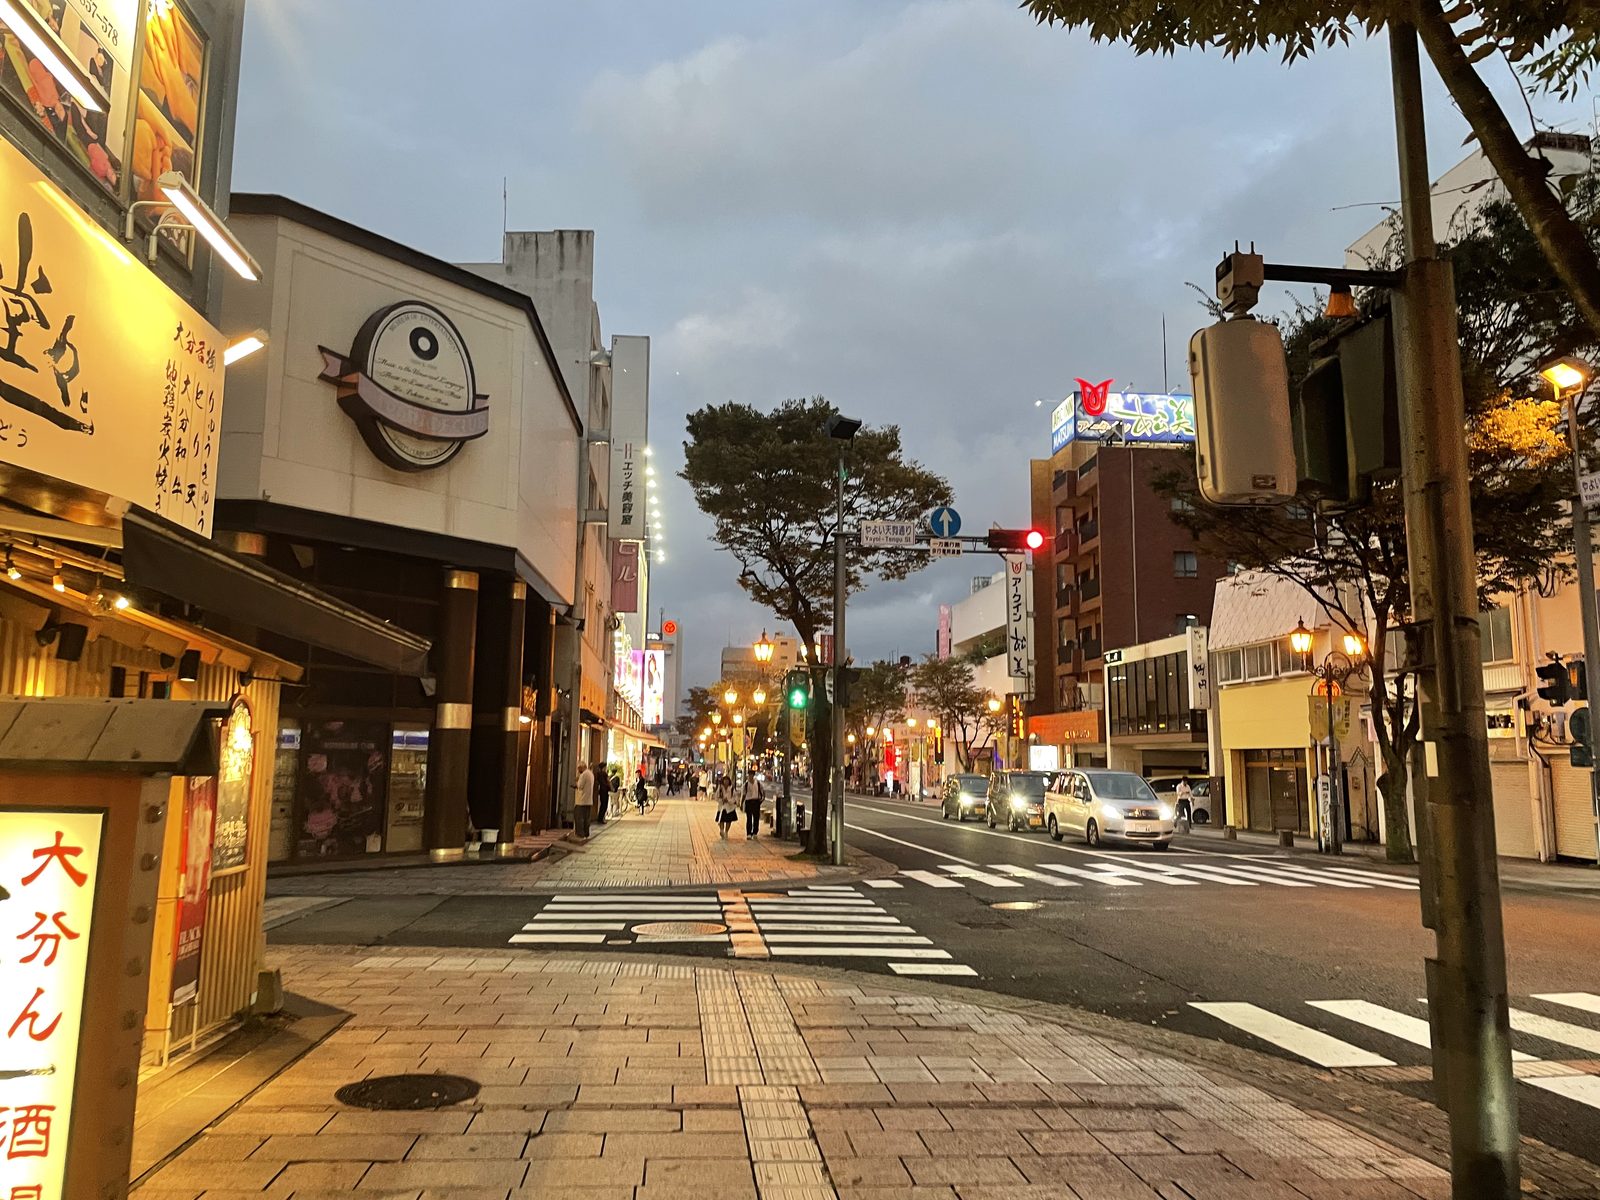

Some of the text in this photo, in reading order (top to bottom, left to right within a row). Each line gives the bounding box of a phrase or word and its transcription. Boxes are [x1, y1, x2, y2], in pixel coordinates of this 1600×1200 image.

[198, 389, 216, 533] りゅうきゅう
[620, 461, 634, 525] エッチ美容室
[865, 525, 912, 536] やよい天狗通り
[1012, 577, 1022, 622] アークイン
